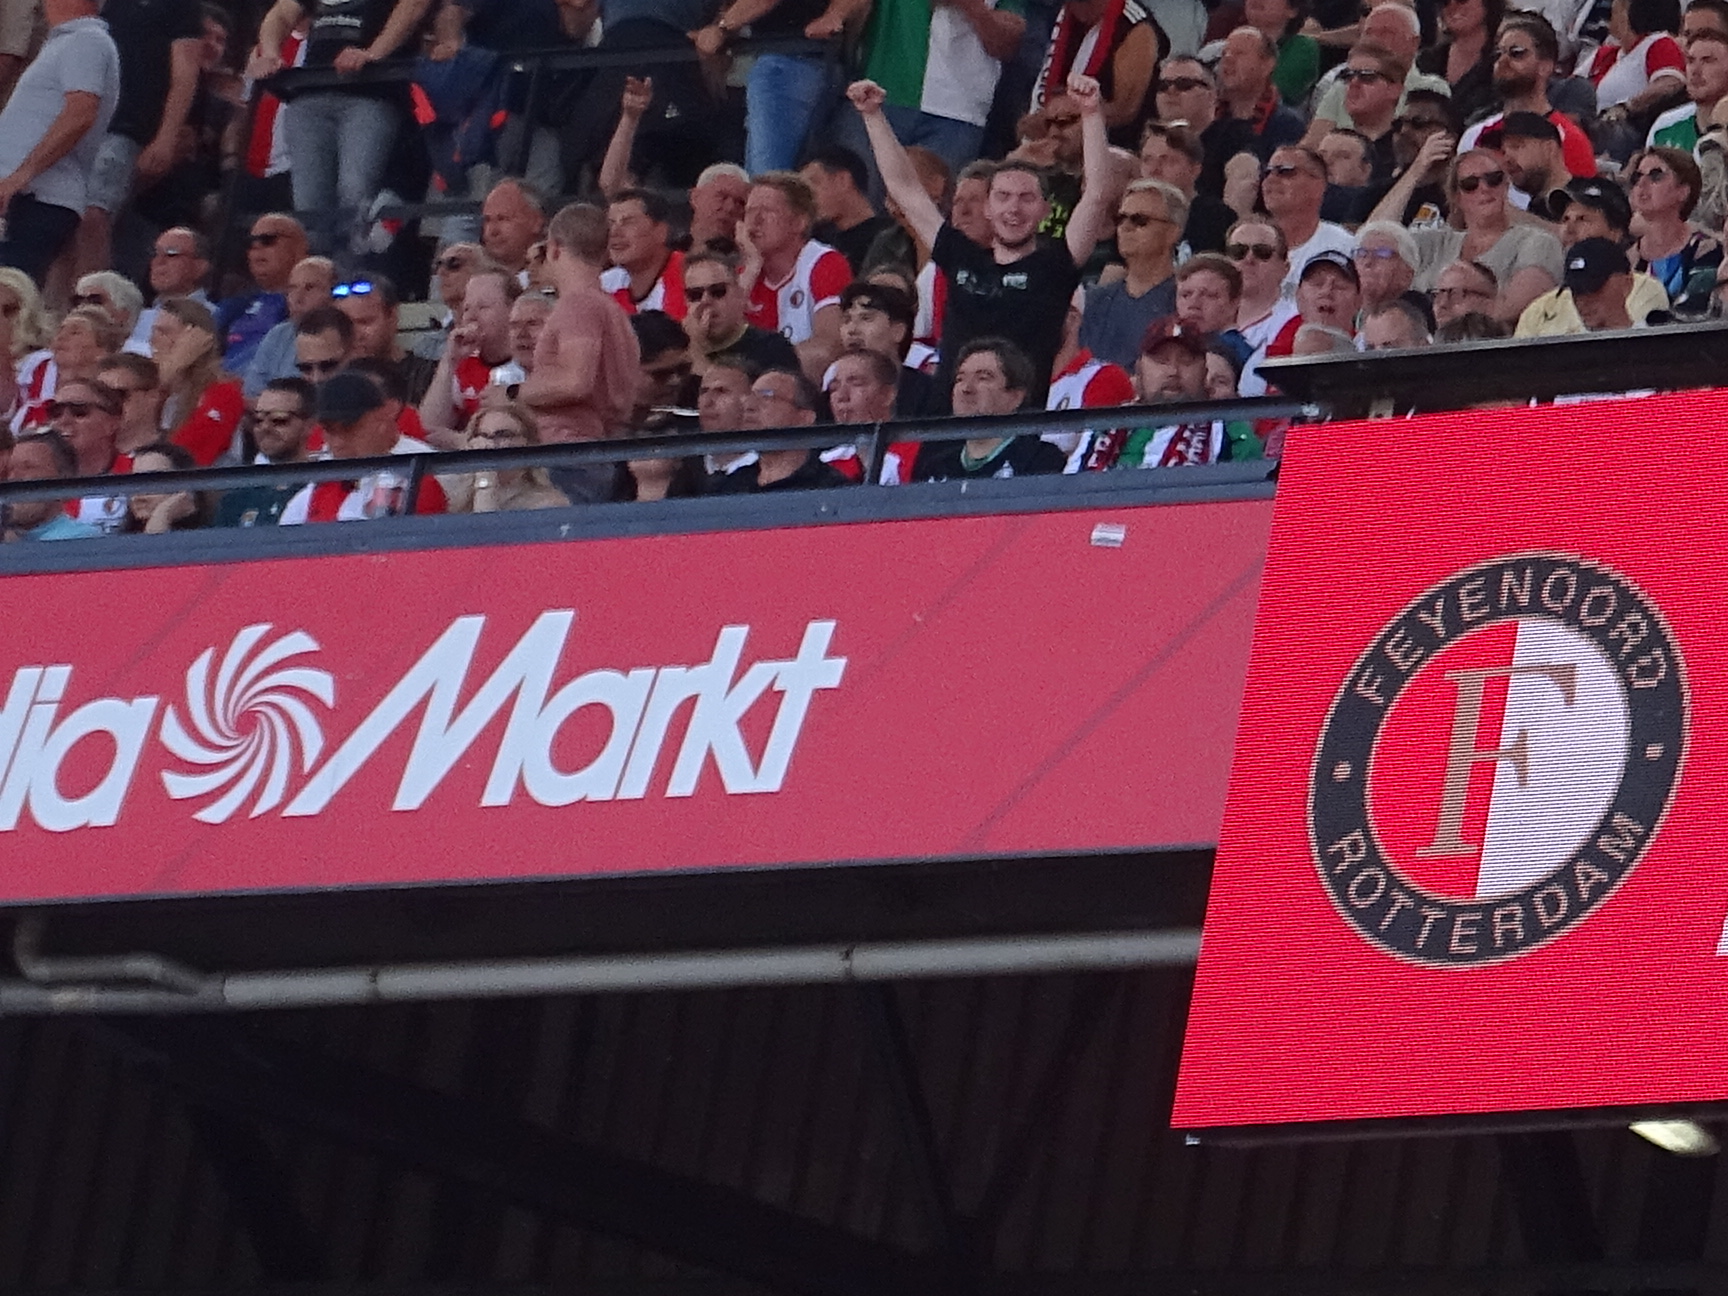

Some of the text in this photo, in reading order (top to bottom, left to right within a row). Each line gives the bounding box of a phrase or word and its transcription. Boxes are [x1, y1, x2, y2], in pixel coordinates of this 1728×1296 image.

[282, 609, 848, 817] Markt
[1353, 567, 1669, 707] FEYENOORD
[1414, 662, 1578, 856] F
[1326, 809, 1646, 956] ROTTERDAM
